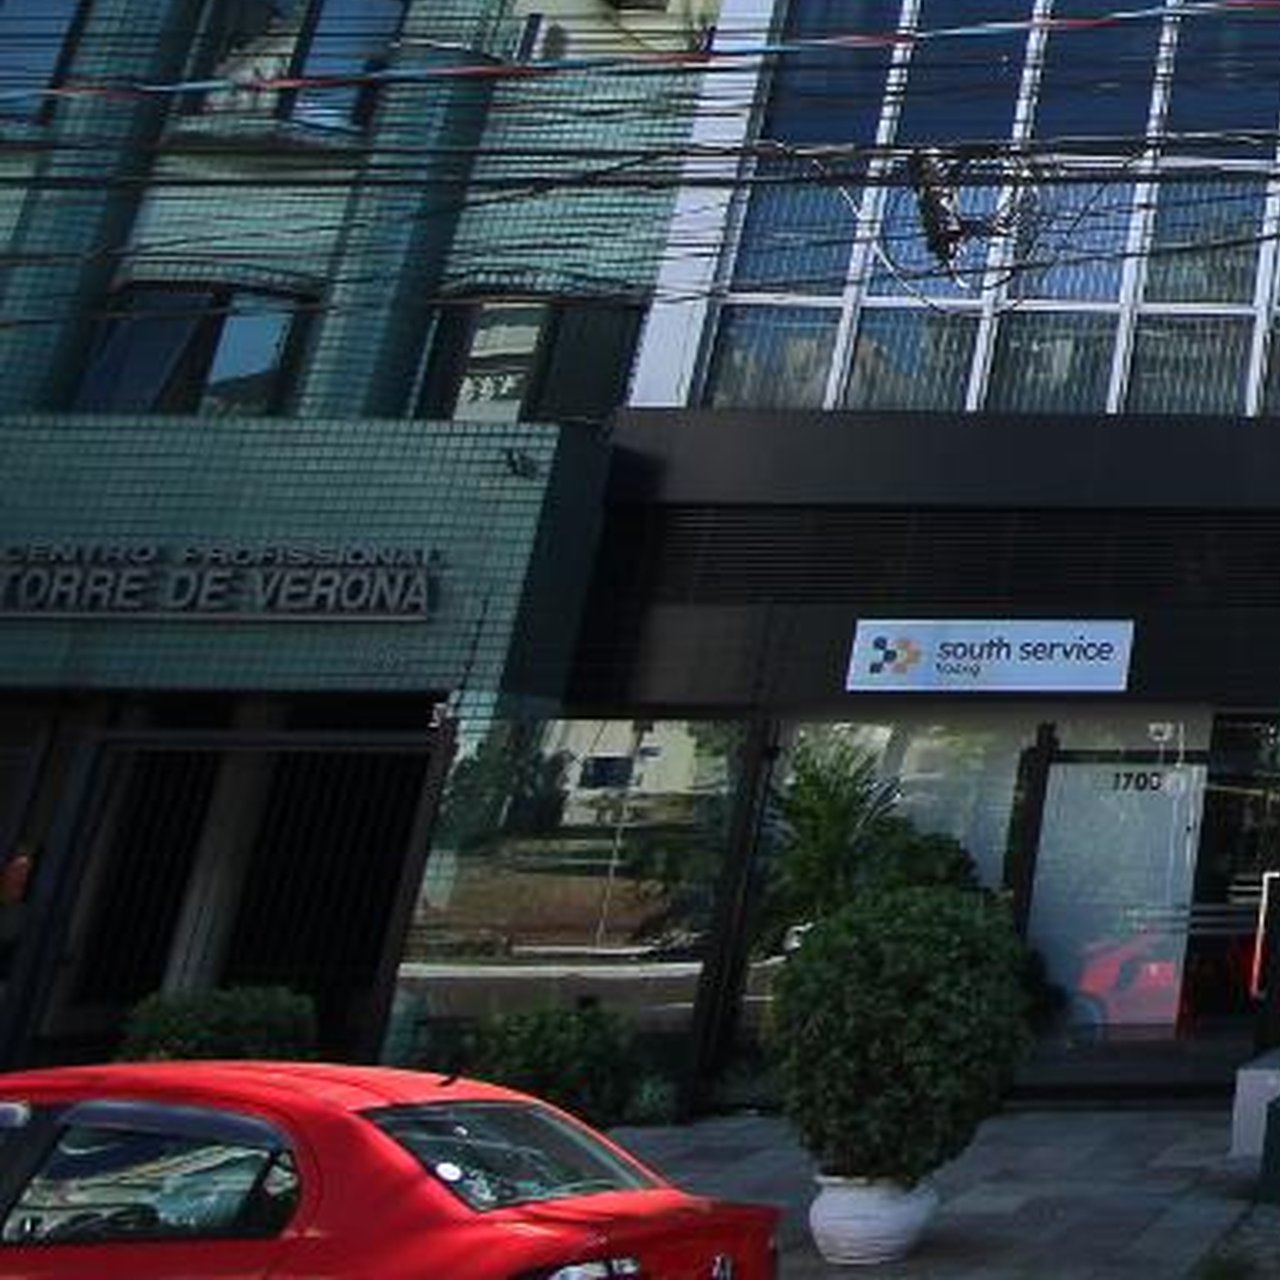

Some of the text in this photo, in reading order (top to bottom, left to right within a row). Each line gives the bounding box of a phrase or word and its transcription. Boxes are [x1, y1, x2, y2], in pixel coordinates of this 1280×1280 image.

[163, 570, 232, 609] DE
[255, 570, 429, 610] VERONA
[936, 636, 1114, 661] south service
